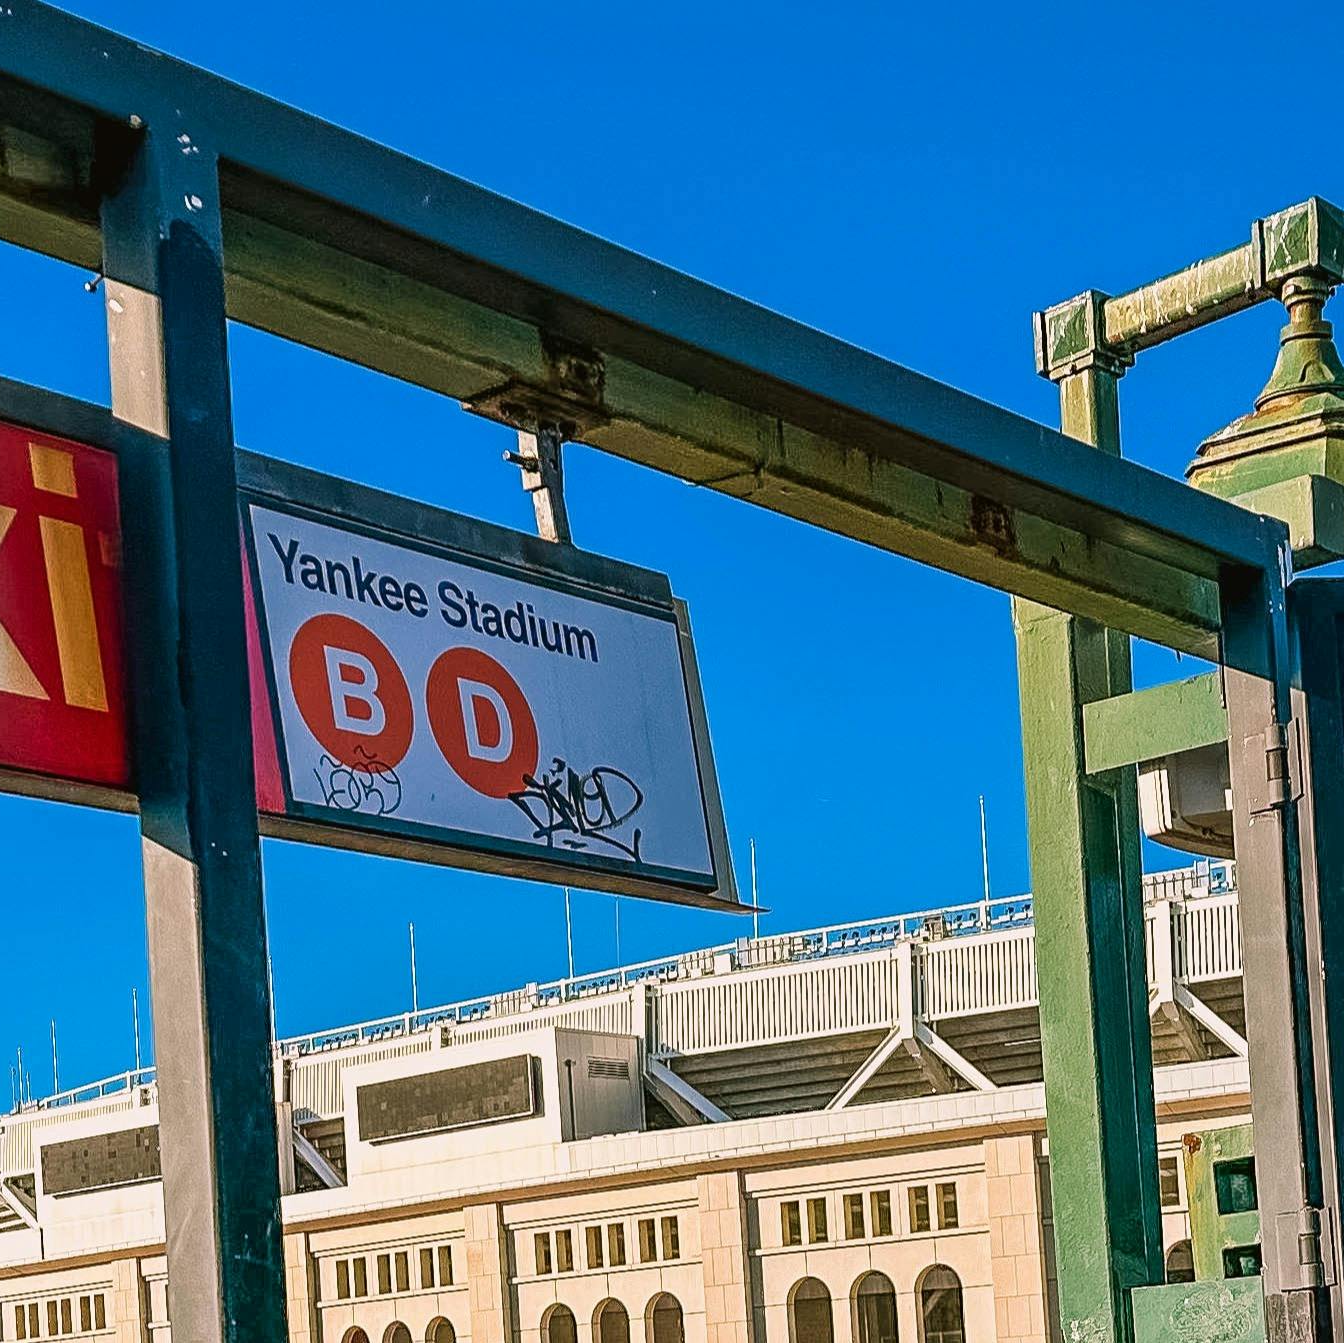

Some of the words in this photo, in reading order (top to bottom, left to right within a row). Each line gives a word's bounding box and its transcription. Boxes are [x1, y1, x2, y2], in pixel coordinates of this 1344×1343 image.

[267, 533, 429, 618] Yankee
[438, 580, 598, 663] Stadium
[323, 645, 386, 736] B
[457, 677, 513, 763] D
